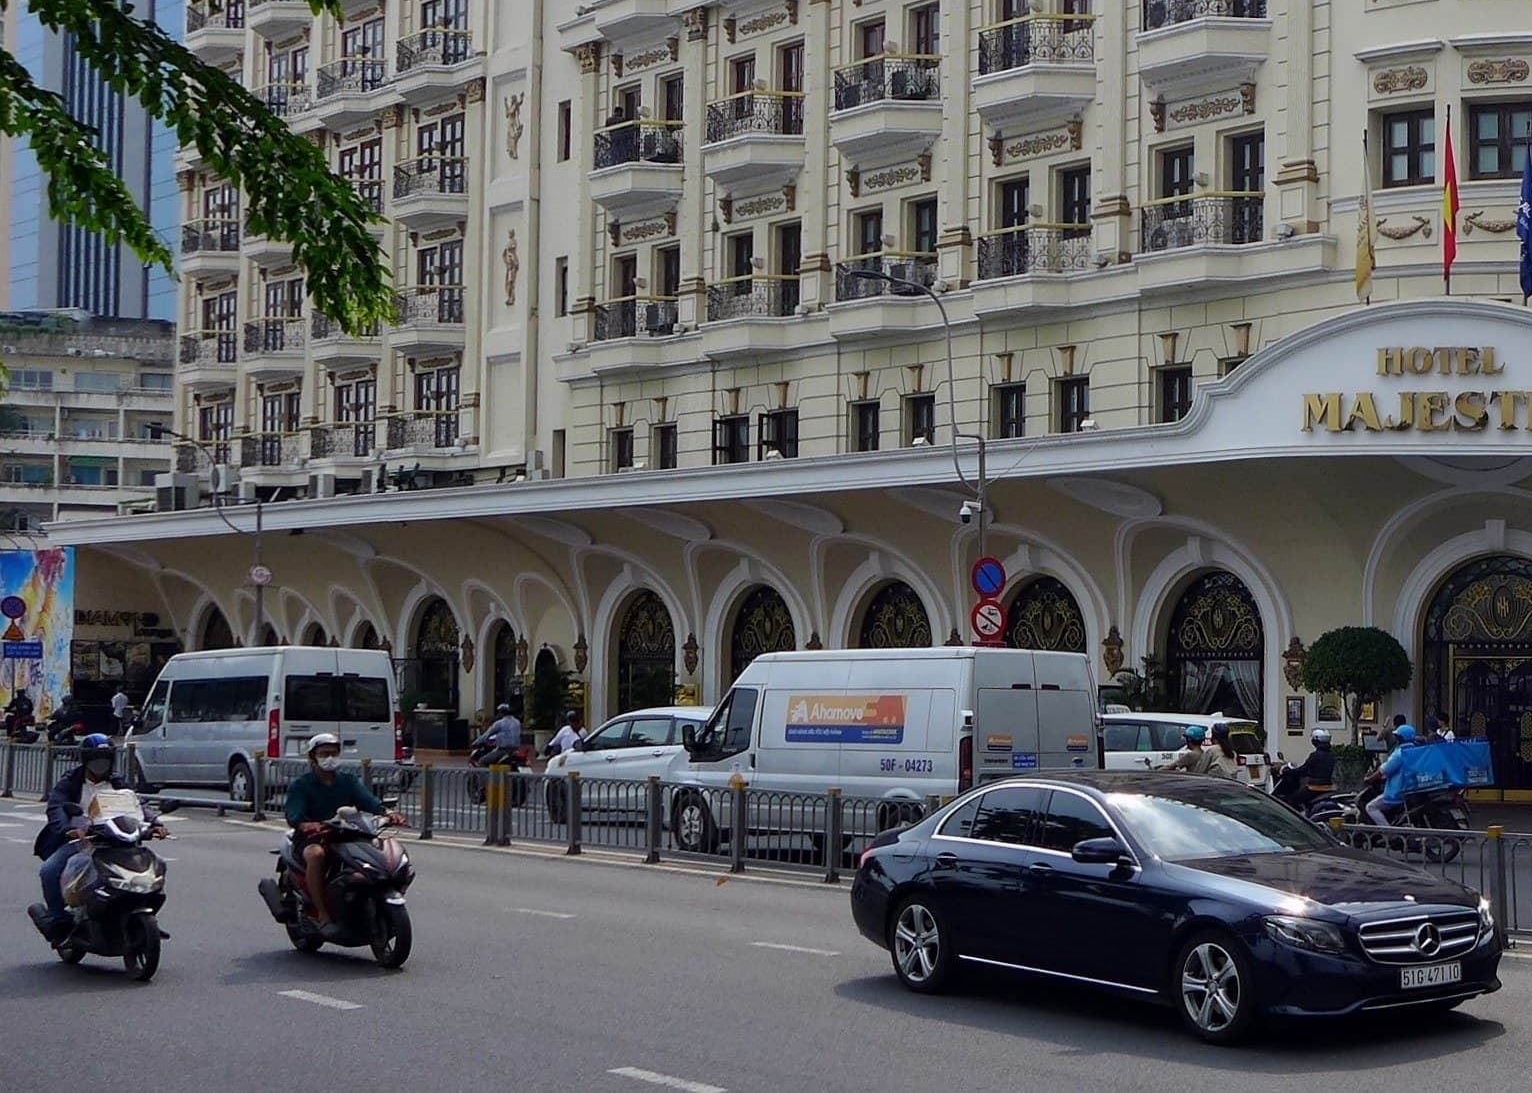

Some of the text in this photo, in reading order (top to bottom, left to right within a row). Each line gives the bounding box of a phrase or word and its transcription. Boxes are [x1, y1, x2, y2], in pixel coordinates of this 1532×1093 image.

[1376, 346, 1506, 376] HOTEL
[810, 703, 864, 720] Ahamove
[880, 758, 897, 772] 50F
[904, 759, 933, 773] 04273
[1403, 969, 1424, 986] 51G
